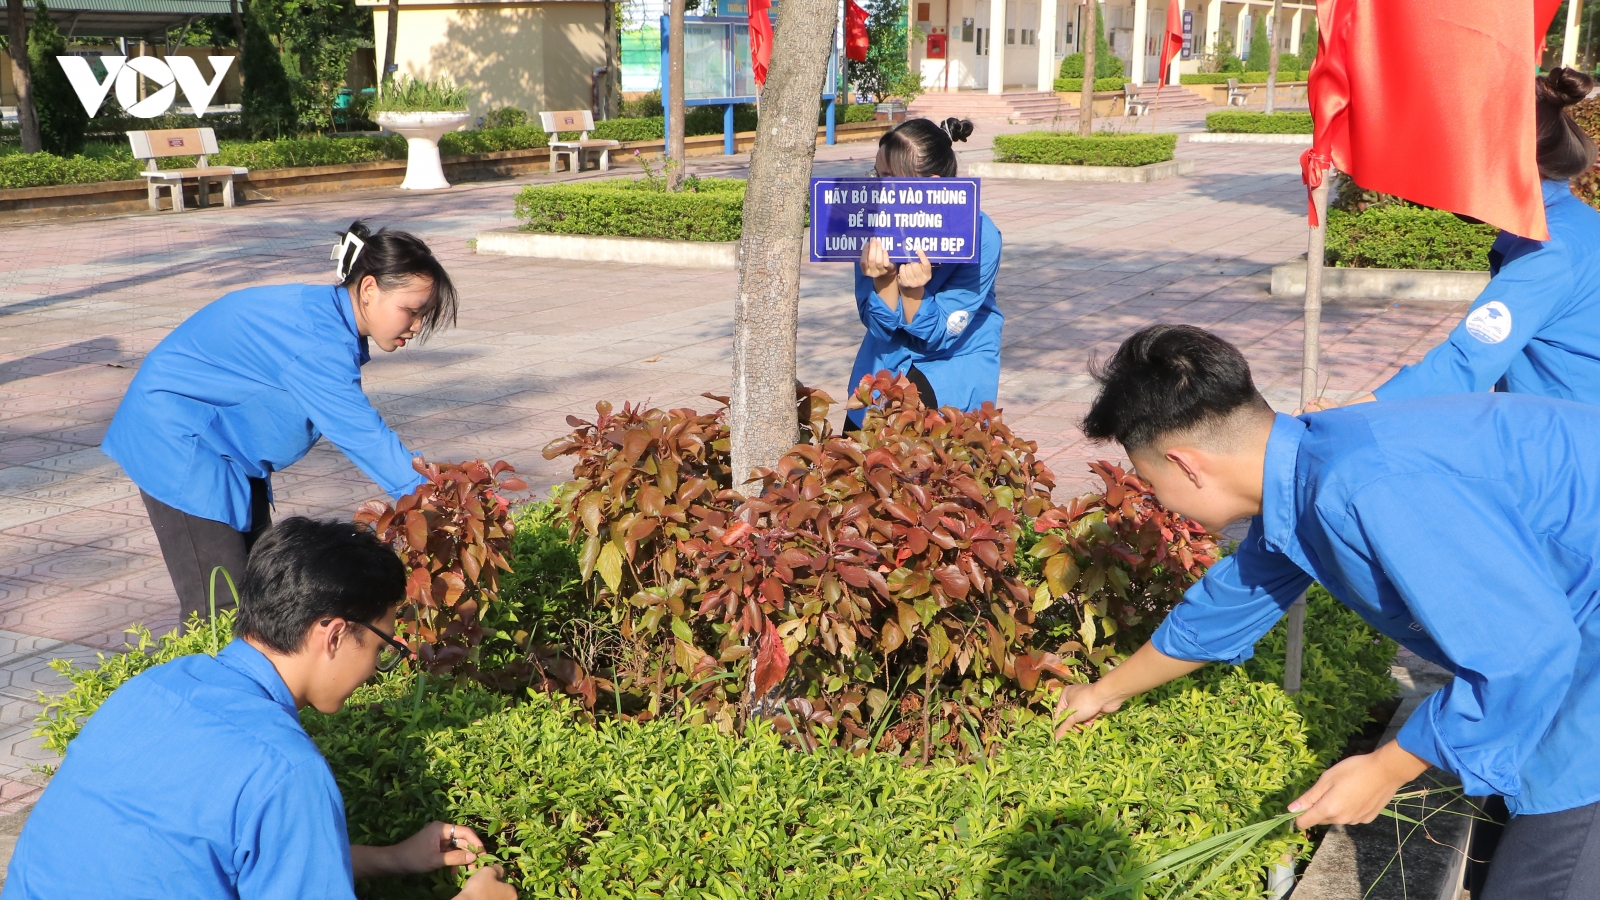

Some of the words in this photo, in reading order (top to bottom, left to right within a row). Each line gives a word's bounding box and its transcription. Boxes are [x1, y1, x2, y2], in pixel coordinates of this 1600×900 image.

[824, 187, 848, 204] HÃY
[851, 185, 868, 204] BỎ
[871, 187, 895, 204] RÁC
[899, 187, 923, 204] VÀO
[926, 187, 966, 204] THÙNG
[848, 208, 864, 228] ĐỂ
[867, 210, 891, 228] MÔI
[894, 210, 943, 228] TRƯỜNG
[825, 234, 857, 251] LUÔN
[860, 236, 894, 251] XNH
[940, 237, 965, 255] ĐẸP
